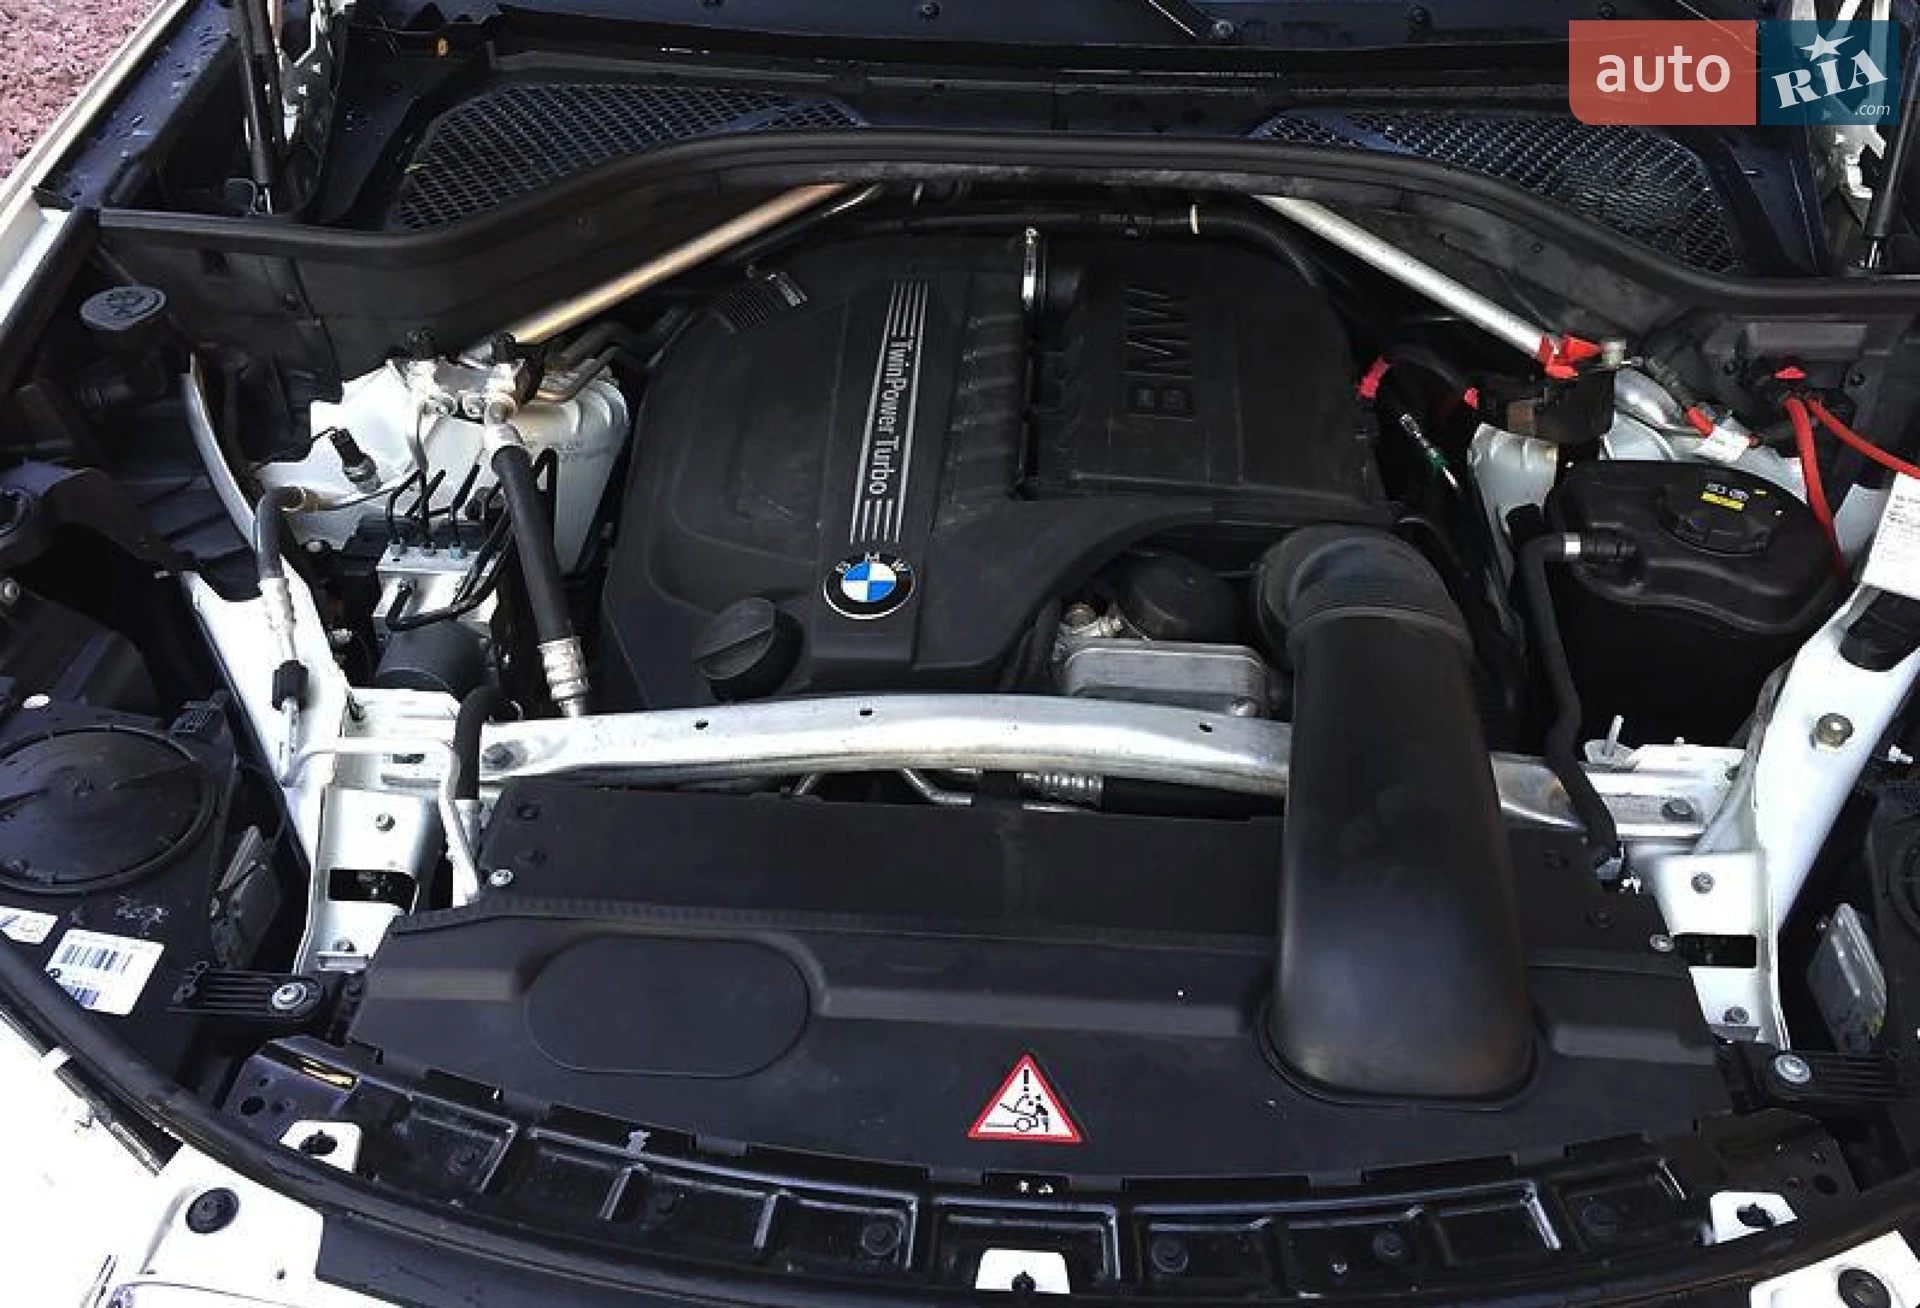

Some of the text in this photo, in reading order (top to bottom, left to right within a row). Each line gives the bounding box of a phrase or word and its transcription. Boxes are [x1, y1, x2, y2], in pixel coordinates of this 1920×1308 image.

[869, 338, 914, 495] TwinPower Turbo
[1123, 288, 1194, 422] BMW
